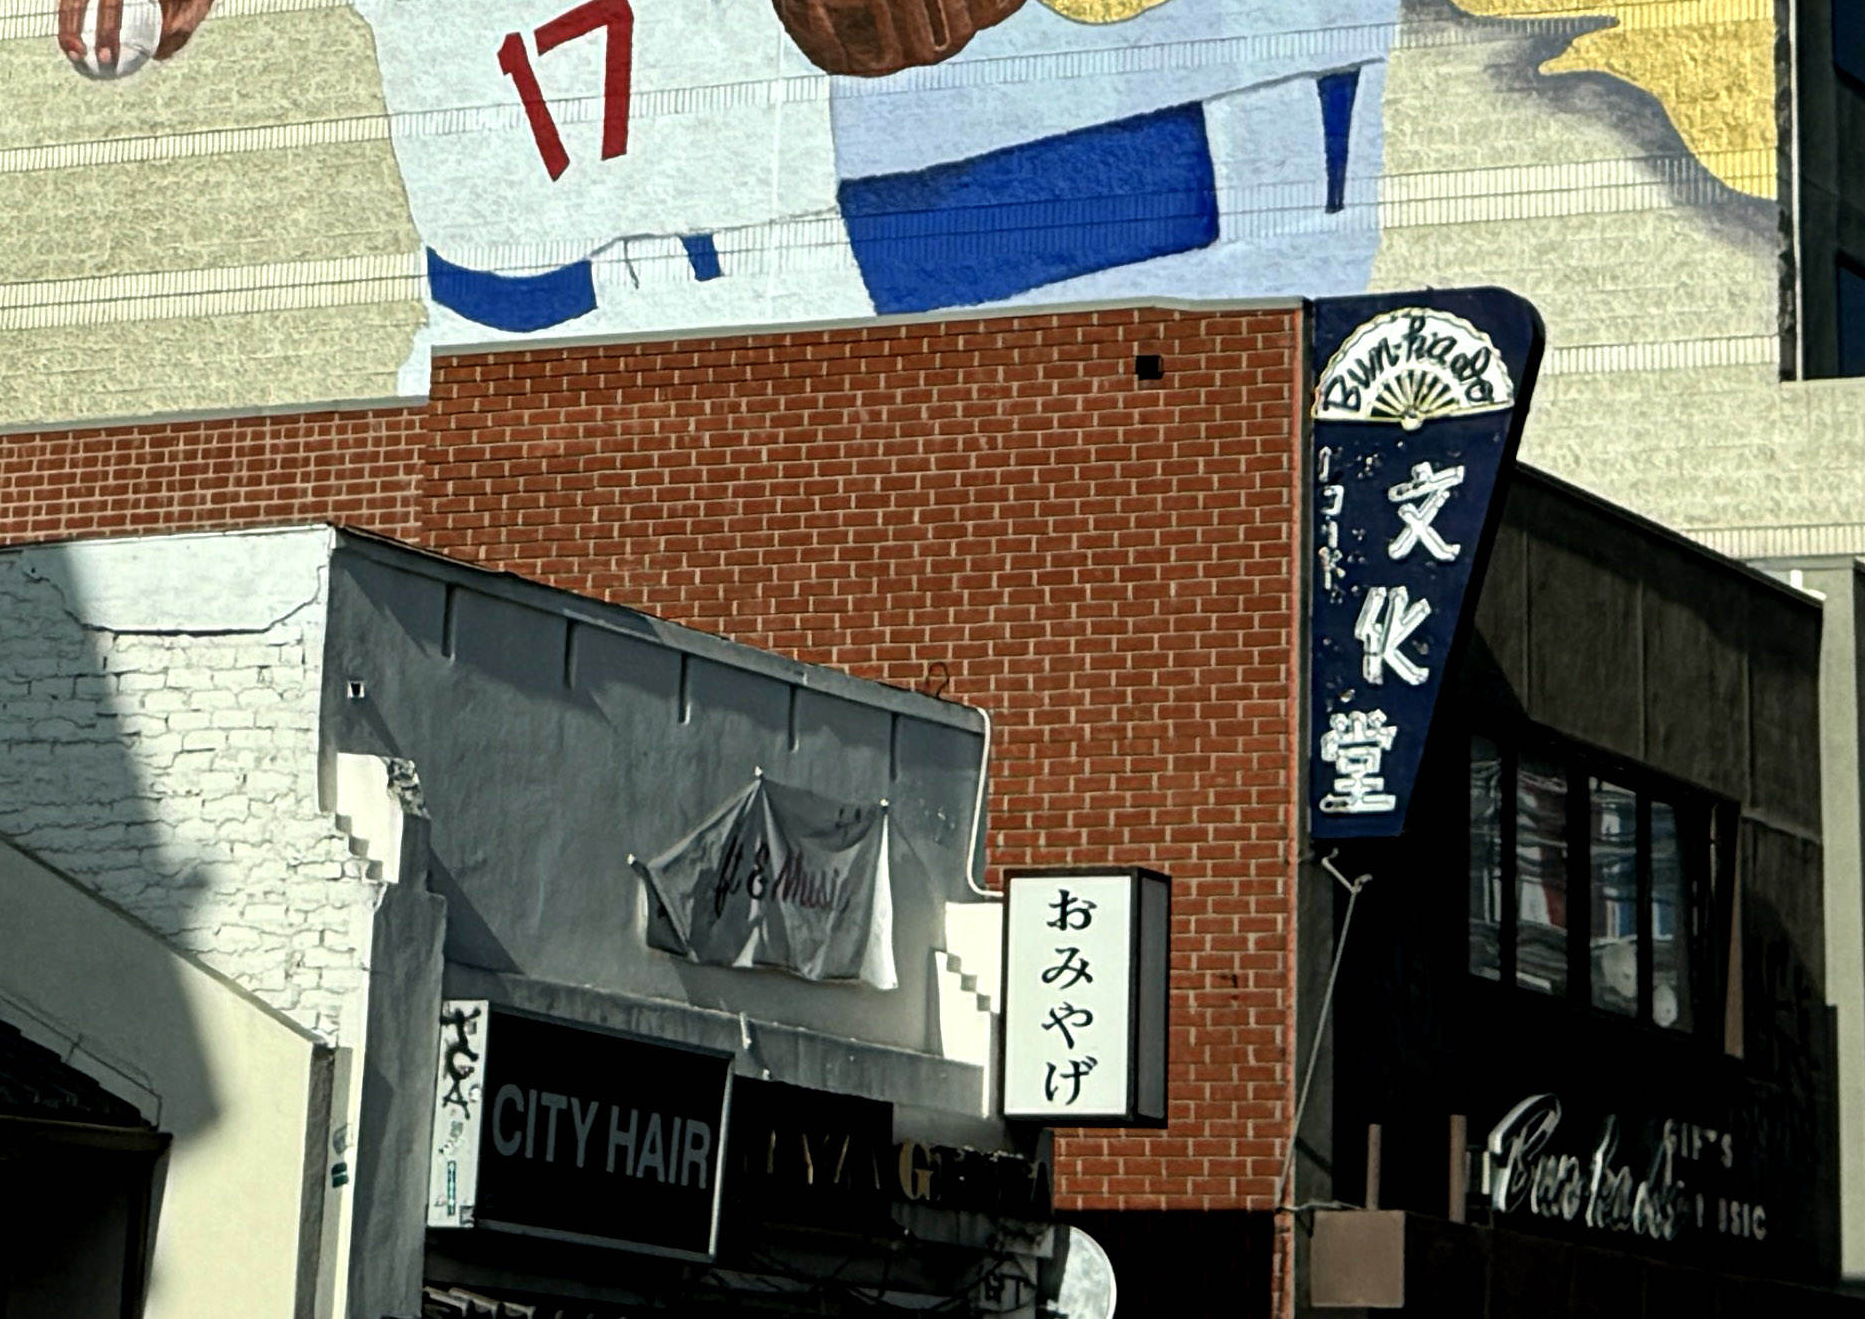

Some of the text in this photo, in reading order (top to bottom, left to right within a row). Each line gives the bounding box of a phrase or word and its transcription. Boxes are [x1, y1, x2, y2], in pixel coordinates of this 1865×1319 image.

[1319, 461, 1465, 813] 文化堂
[1041, 889, 1098, 1106] おみやげ
[491, 1083, 600, 1169] CITY
[606, 1103, 712, 1190] HAIR
